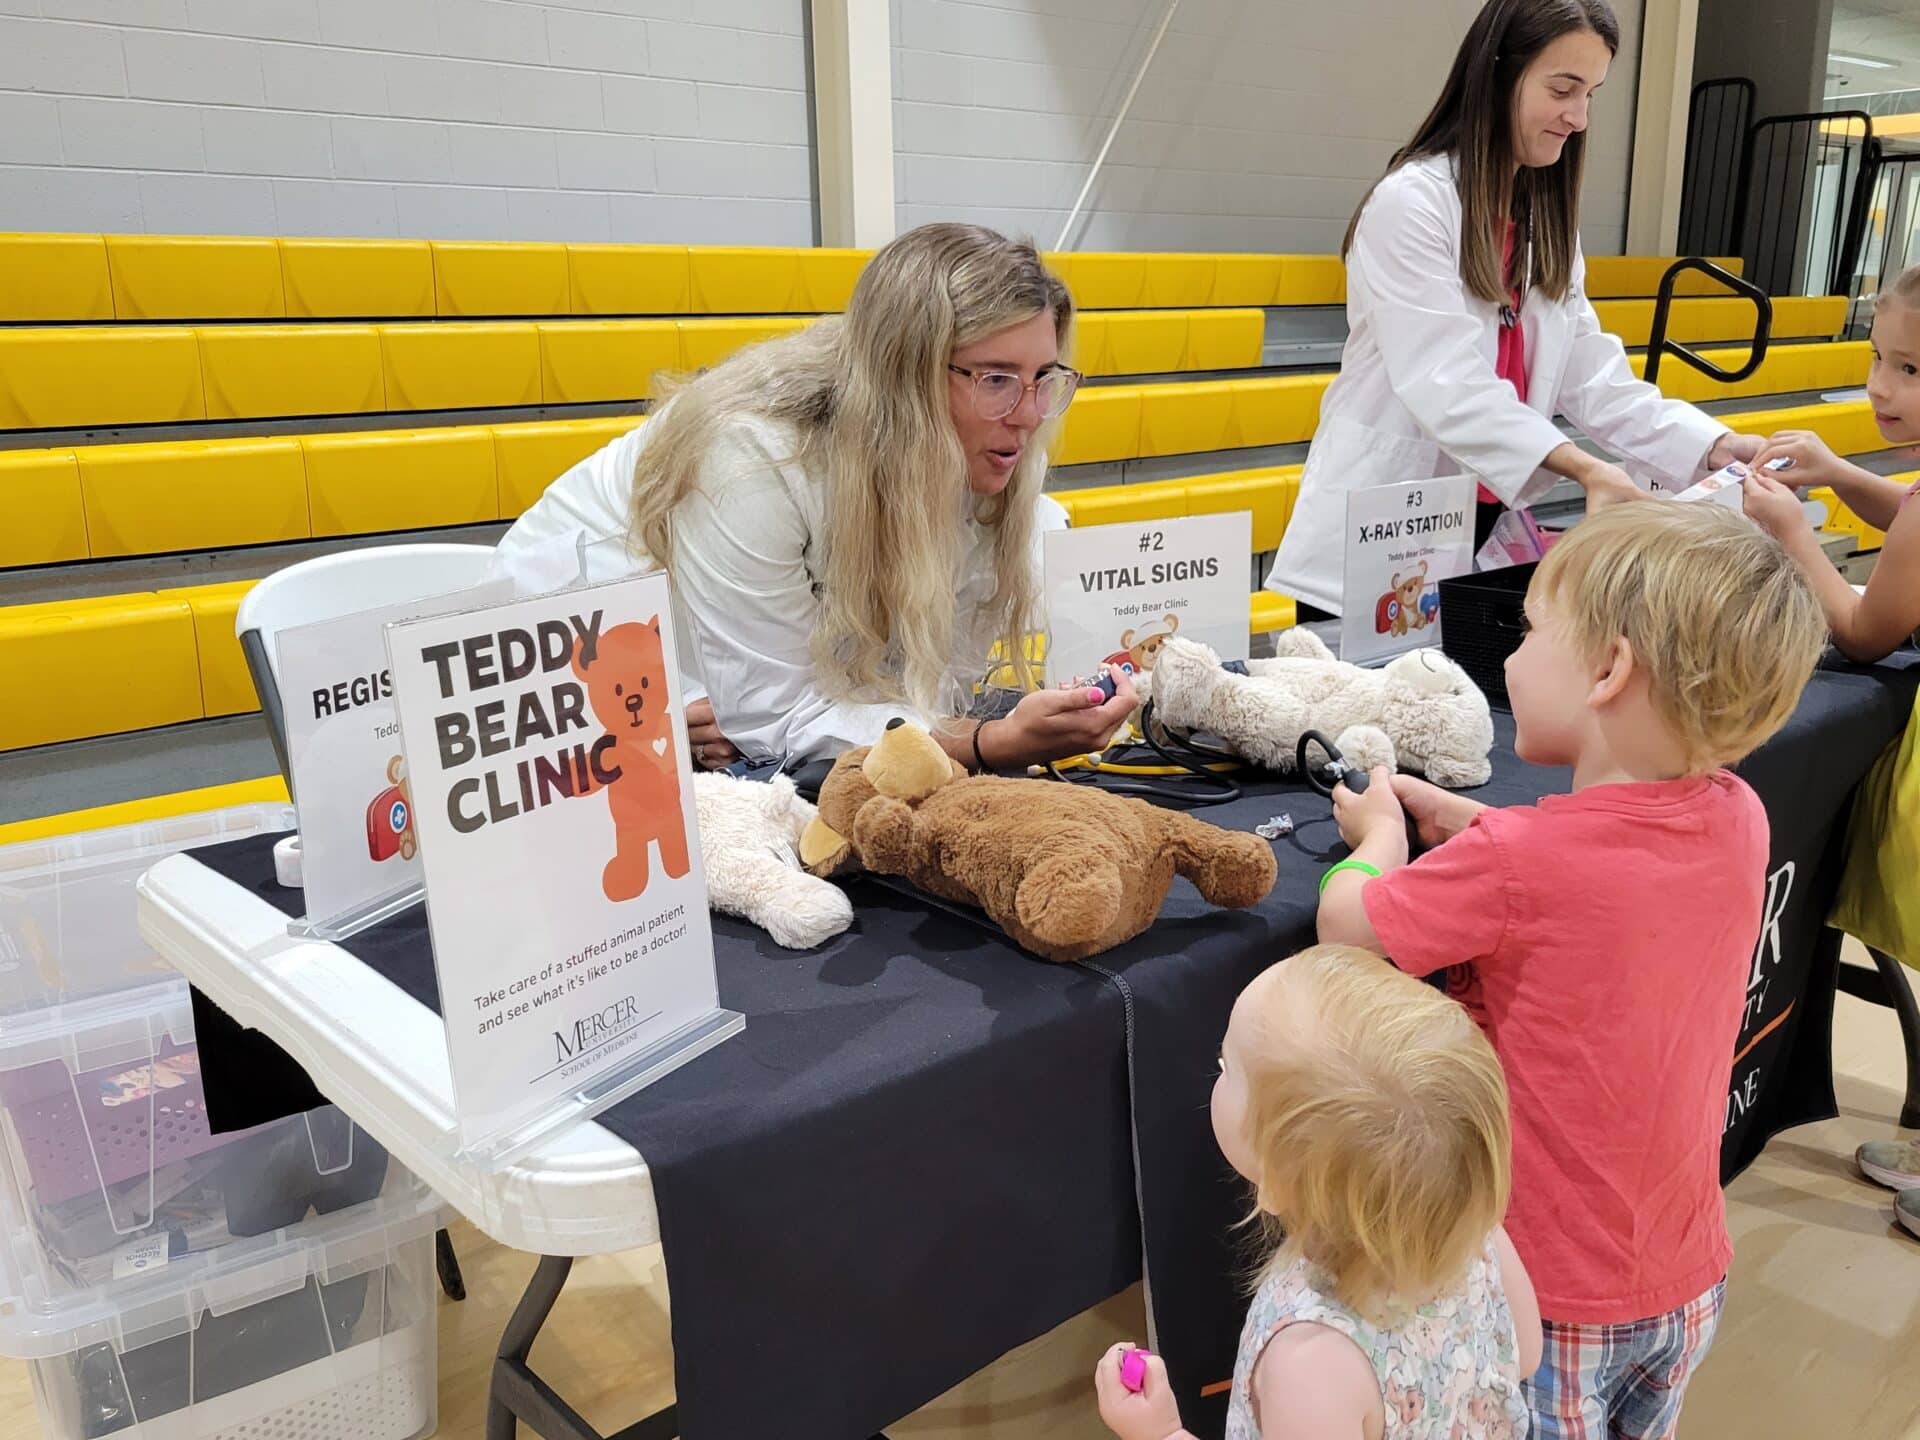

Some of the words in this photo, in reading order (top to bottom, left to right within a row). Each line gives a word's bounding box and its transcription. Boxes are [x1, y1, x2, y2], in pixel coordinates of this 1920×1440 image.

[1359, 520, 1402, 544] X-RAY
[1405, 511, 1463, 535] STATION
[1406, 490, 1423, 508] #3
[1079, 566, 1146, 593] VITAL
[1151, 557, 1219, 583] SIGNS
[1138, 531, 1164, 552] #2
[1112, 604, 1140, 616] Teddy
[1141, 602, 1162, 613] Bear
[1164, 597, 1189, 609] Clinic
[421, 609, 604, 699] TEDDY
[434, 682, 589, 770] BEAR
[447, 734, 623, 834] CLINIC
[473, 989, 507, 1011] Take
[509, 974, 537, 996] care
[540, 963, 553, 981] of
[555, 963, 564, 974] a
[566, 938, 608, 970] stuffed
[610, 920, 646, 949] animal
[648, 904, 685, 932] patient
[478, 1010, 504, 1035] and
[507, 1001, 530, 1021] see
[532, 984, 565, 1008] what
[566, 974, 585, 992] it's
[587, 964, 608, 983] like
[610, 957, 622, 971] to
[624, 949, 639, 964] be
[641, 944, 649, 956] a
[650, 923, 688, 951] doctor!
[552, 995, 640, 1065] MERCER
